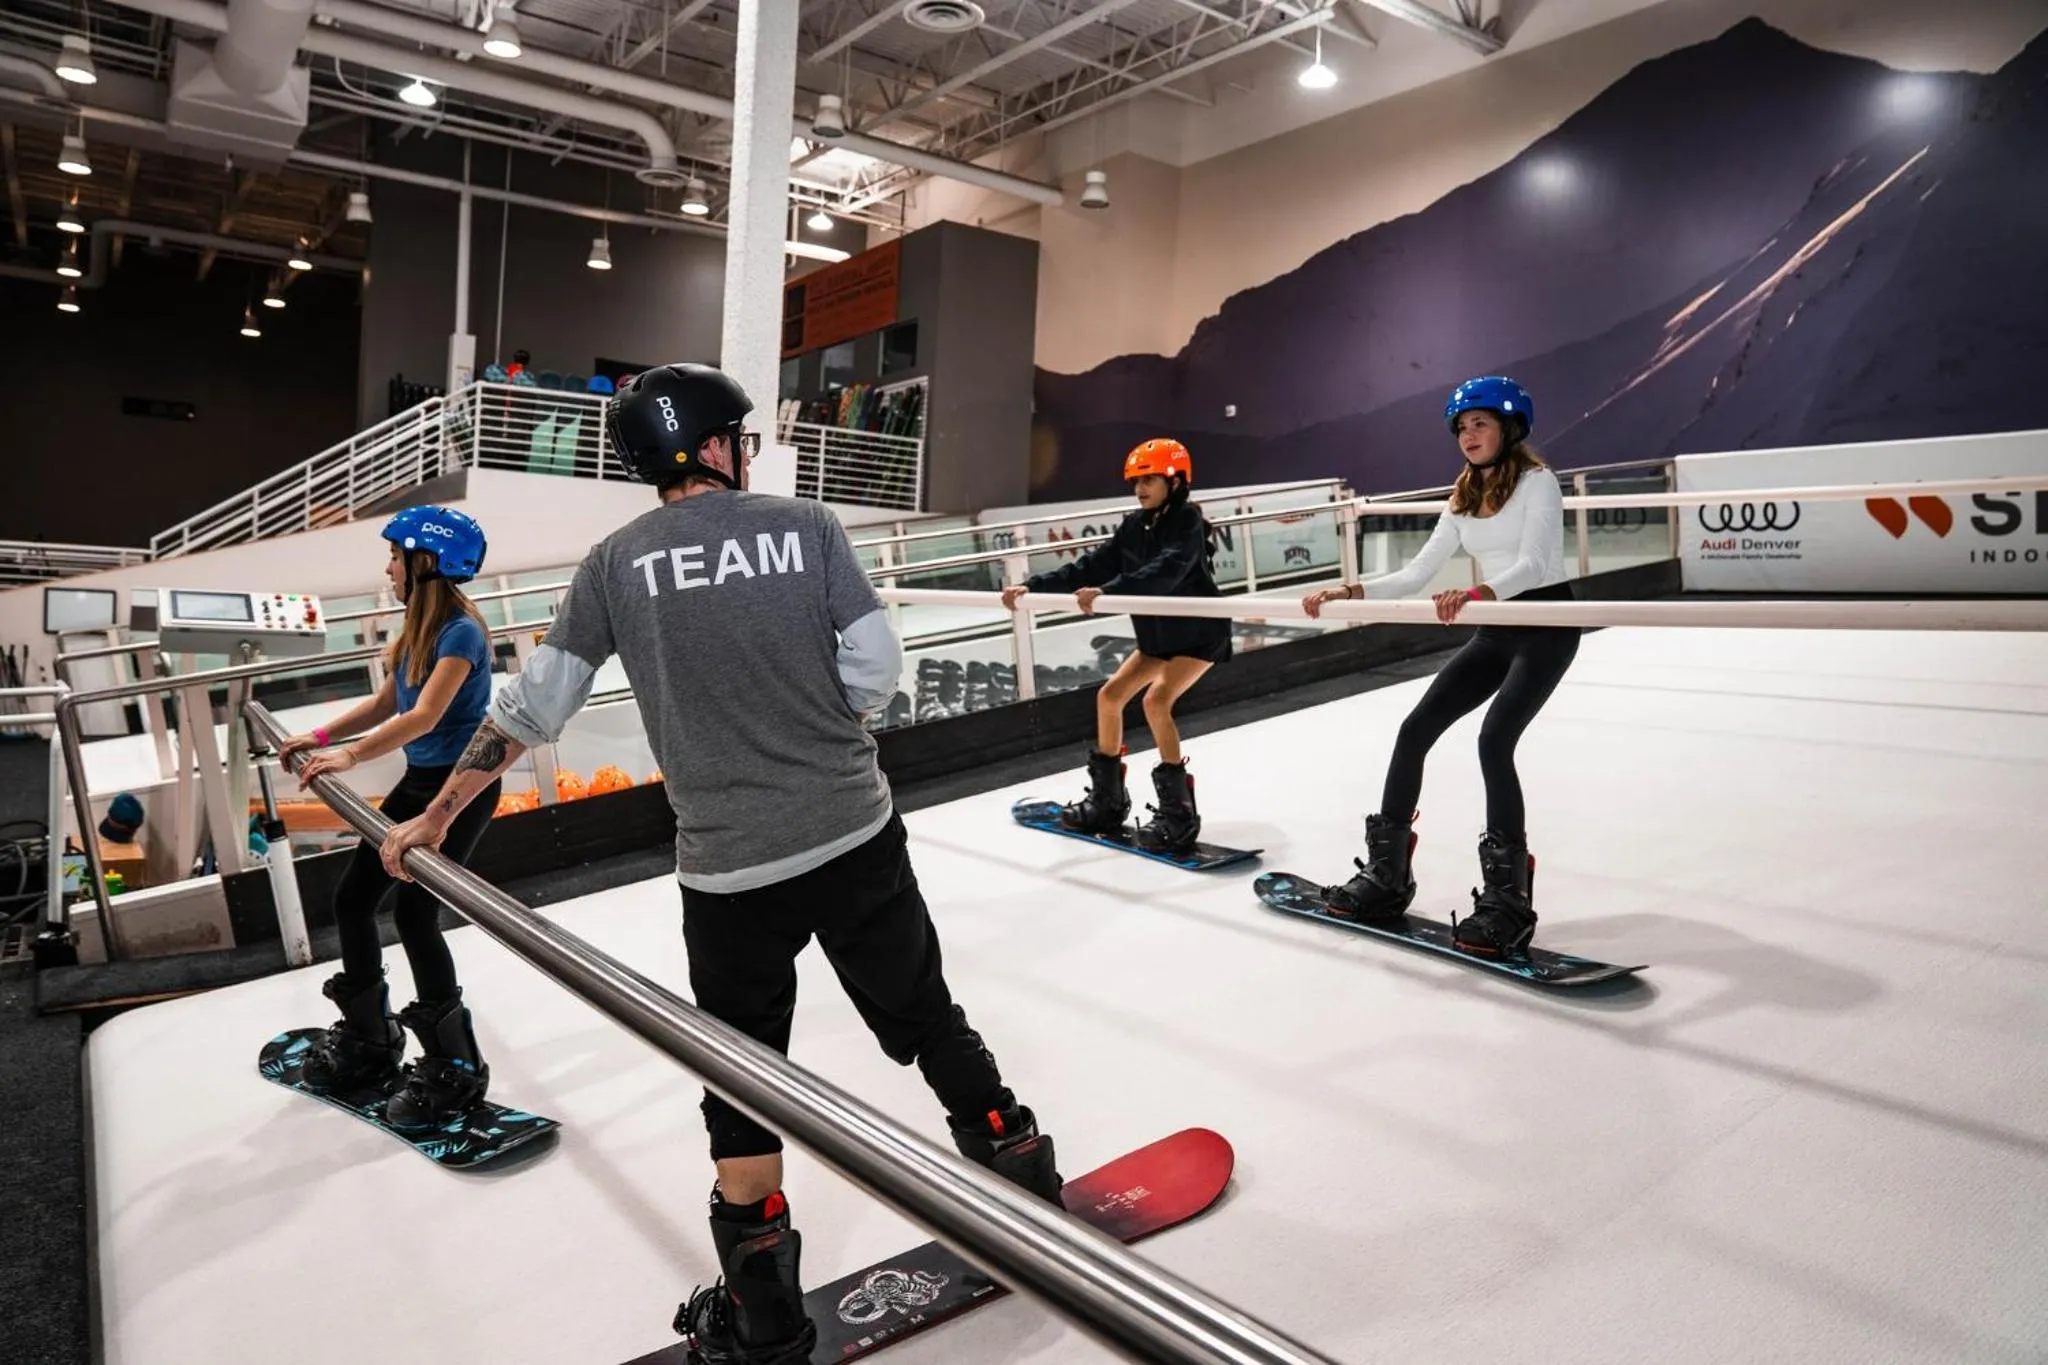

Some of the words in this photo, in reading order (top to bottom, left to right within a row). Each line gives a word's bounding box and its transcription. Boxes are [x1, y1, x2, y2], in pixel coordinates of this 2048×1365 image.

[1700, 538, 1736, 550] Audi
[1741, 538, 1802, 550] Denver
[1969, 548, 2048, 564] INDO
[633, 531, 804, 598] TEAM
